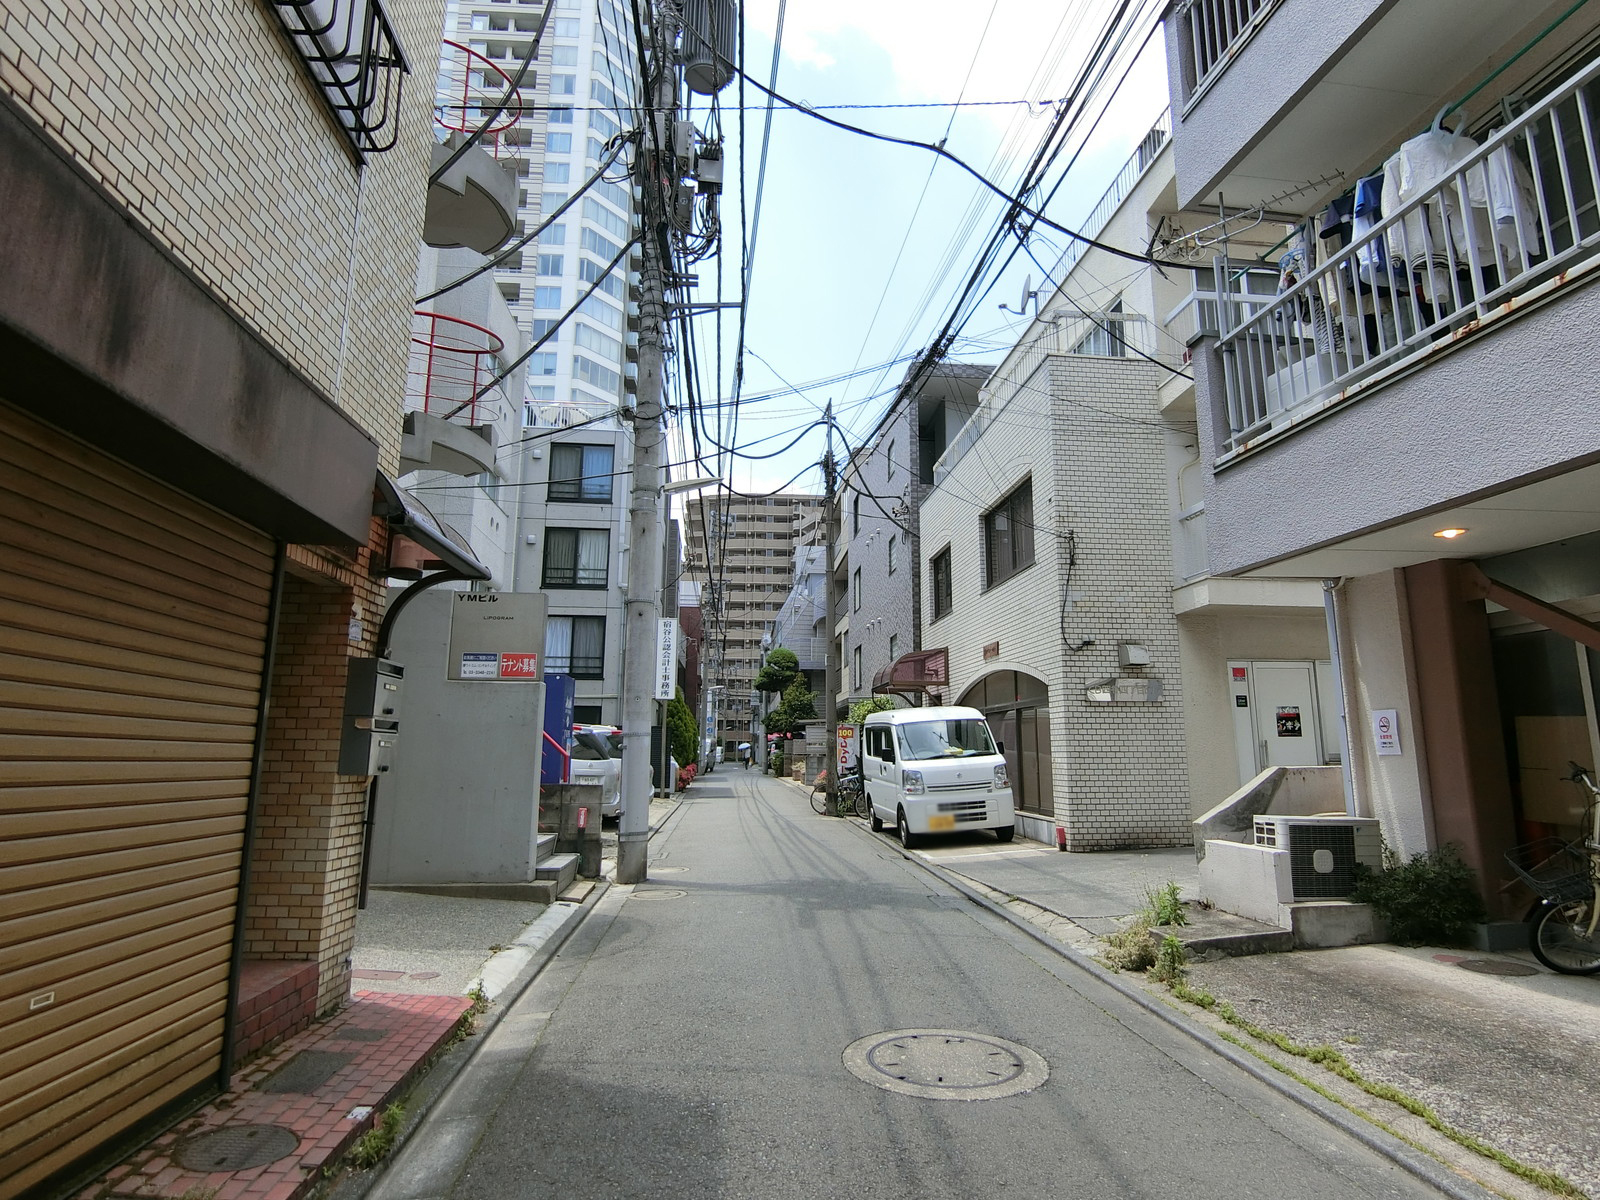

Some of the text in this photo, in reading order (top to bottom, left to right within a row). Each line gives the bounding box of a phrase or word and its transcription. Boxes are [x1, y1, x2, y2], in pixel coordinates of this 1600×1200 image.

[457, 594, 498, 603] YMビル
[501, 658, 536, 672] テナント募集
[660, 621, 672, 697] 宿谷公認会計士事務所
[838, 729, 852, 737] 100
[840, 738, 849, 764] DyD
